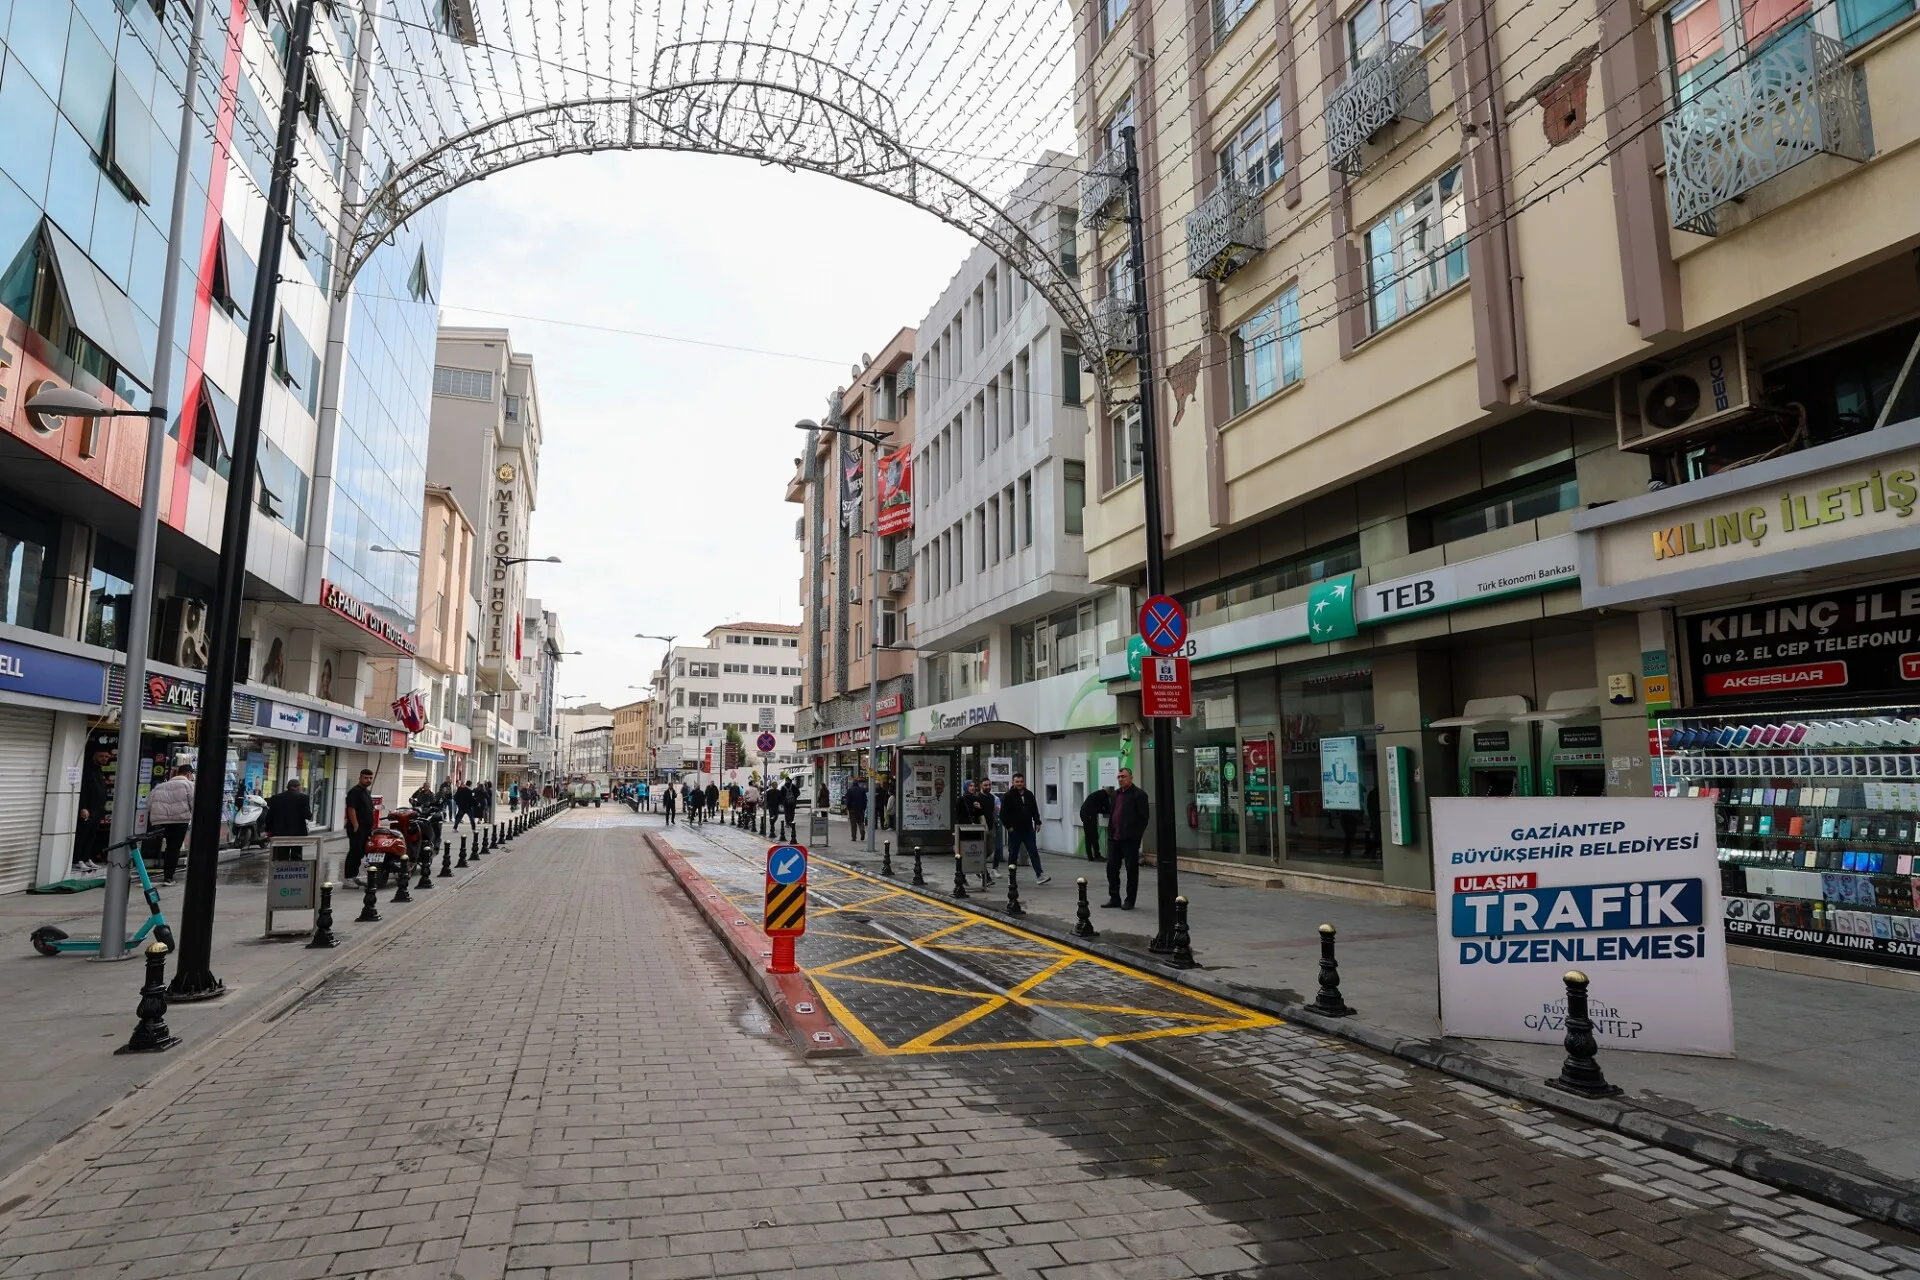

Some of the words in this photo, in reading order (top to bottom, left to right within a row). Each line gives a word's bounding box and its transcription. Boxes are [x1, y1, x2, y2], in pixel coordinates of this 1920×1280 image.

[1709, 354, 1729, 412] BEKO
[496, 489, 514, 528] MET
[1652, 506, 1767, 561] KILINÇ
[493, 530, 510, 583] GOLD
[1376, 579, 1436, 613] TEB
[1477, 582, 1497, 593] Türk
[1498, 571, 1537, 588] Ekonomi
[1538, 564, 1576, 579] Bankası
[338, 591, 368, 625] PAMUK
[385, 624, 405, 648] HOTEL
[489, 586, 505, 652] HOTEL
[1700, 600, 1840, 643] KILINÇ
[1702, 654, 1712, 666] 0
[1715, 652, 1732, 664] ve
[1736, 649, 1748, 662] 2.
[1753, 645, 1772, 660] EL
[1776, 641, 1810, 657] CEP
[1814, 629, 1912, 653] TELEFONU
[1159, 674, 1174, 682] EDS
[1723, 669, 1824, 689] AKSESUAR
[166, 684, 198, 712] AYTAÇ
[939, 710, 967, 729] Garanti
[1450, 841, 1574, 865] BÜYÜKŞEHİR
[1579, 832, 1699, 857] BELEDİYESİ
[1510, 820, 1626, 841] GAZİANTEP
[1459, 875, 1529, 893] ULAŞIM
[1464, 882, 1689, 934] TRAFİK
[1459, 926, 1705, 965] DÜZENLEMESİ
[1728, 920, 1753, 934] CEP
[1755, 923, 1824, 945] TELEFONU
[1825, 933, 1875, 950] ALINIR
[1523, 1014, 1643, 1040] GAZNTEP
[1543, 1001, 1620, 1019] BÜYEHİR
